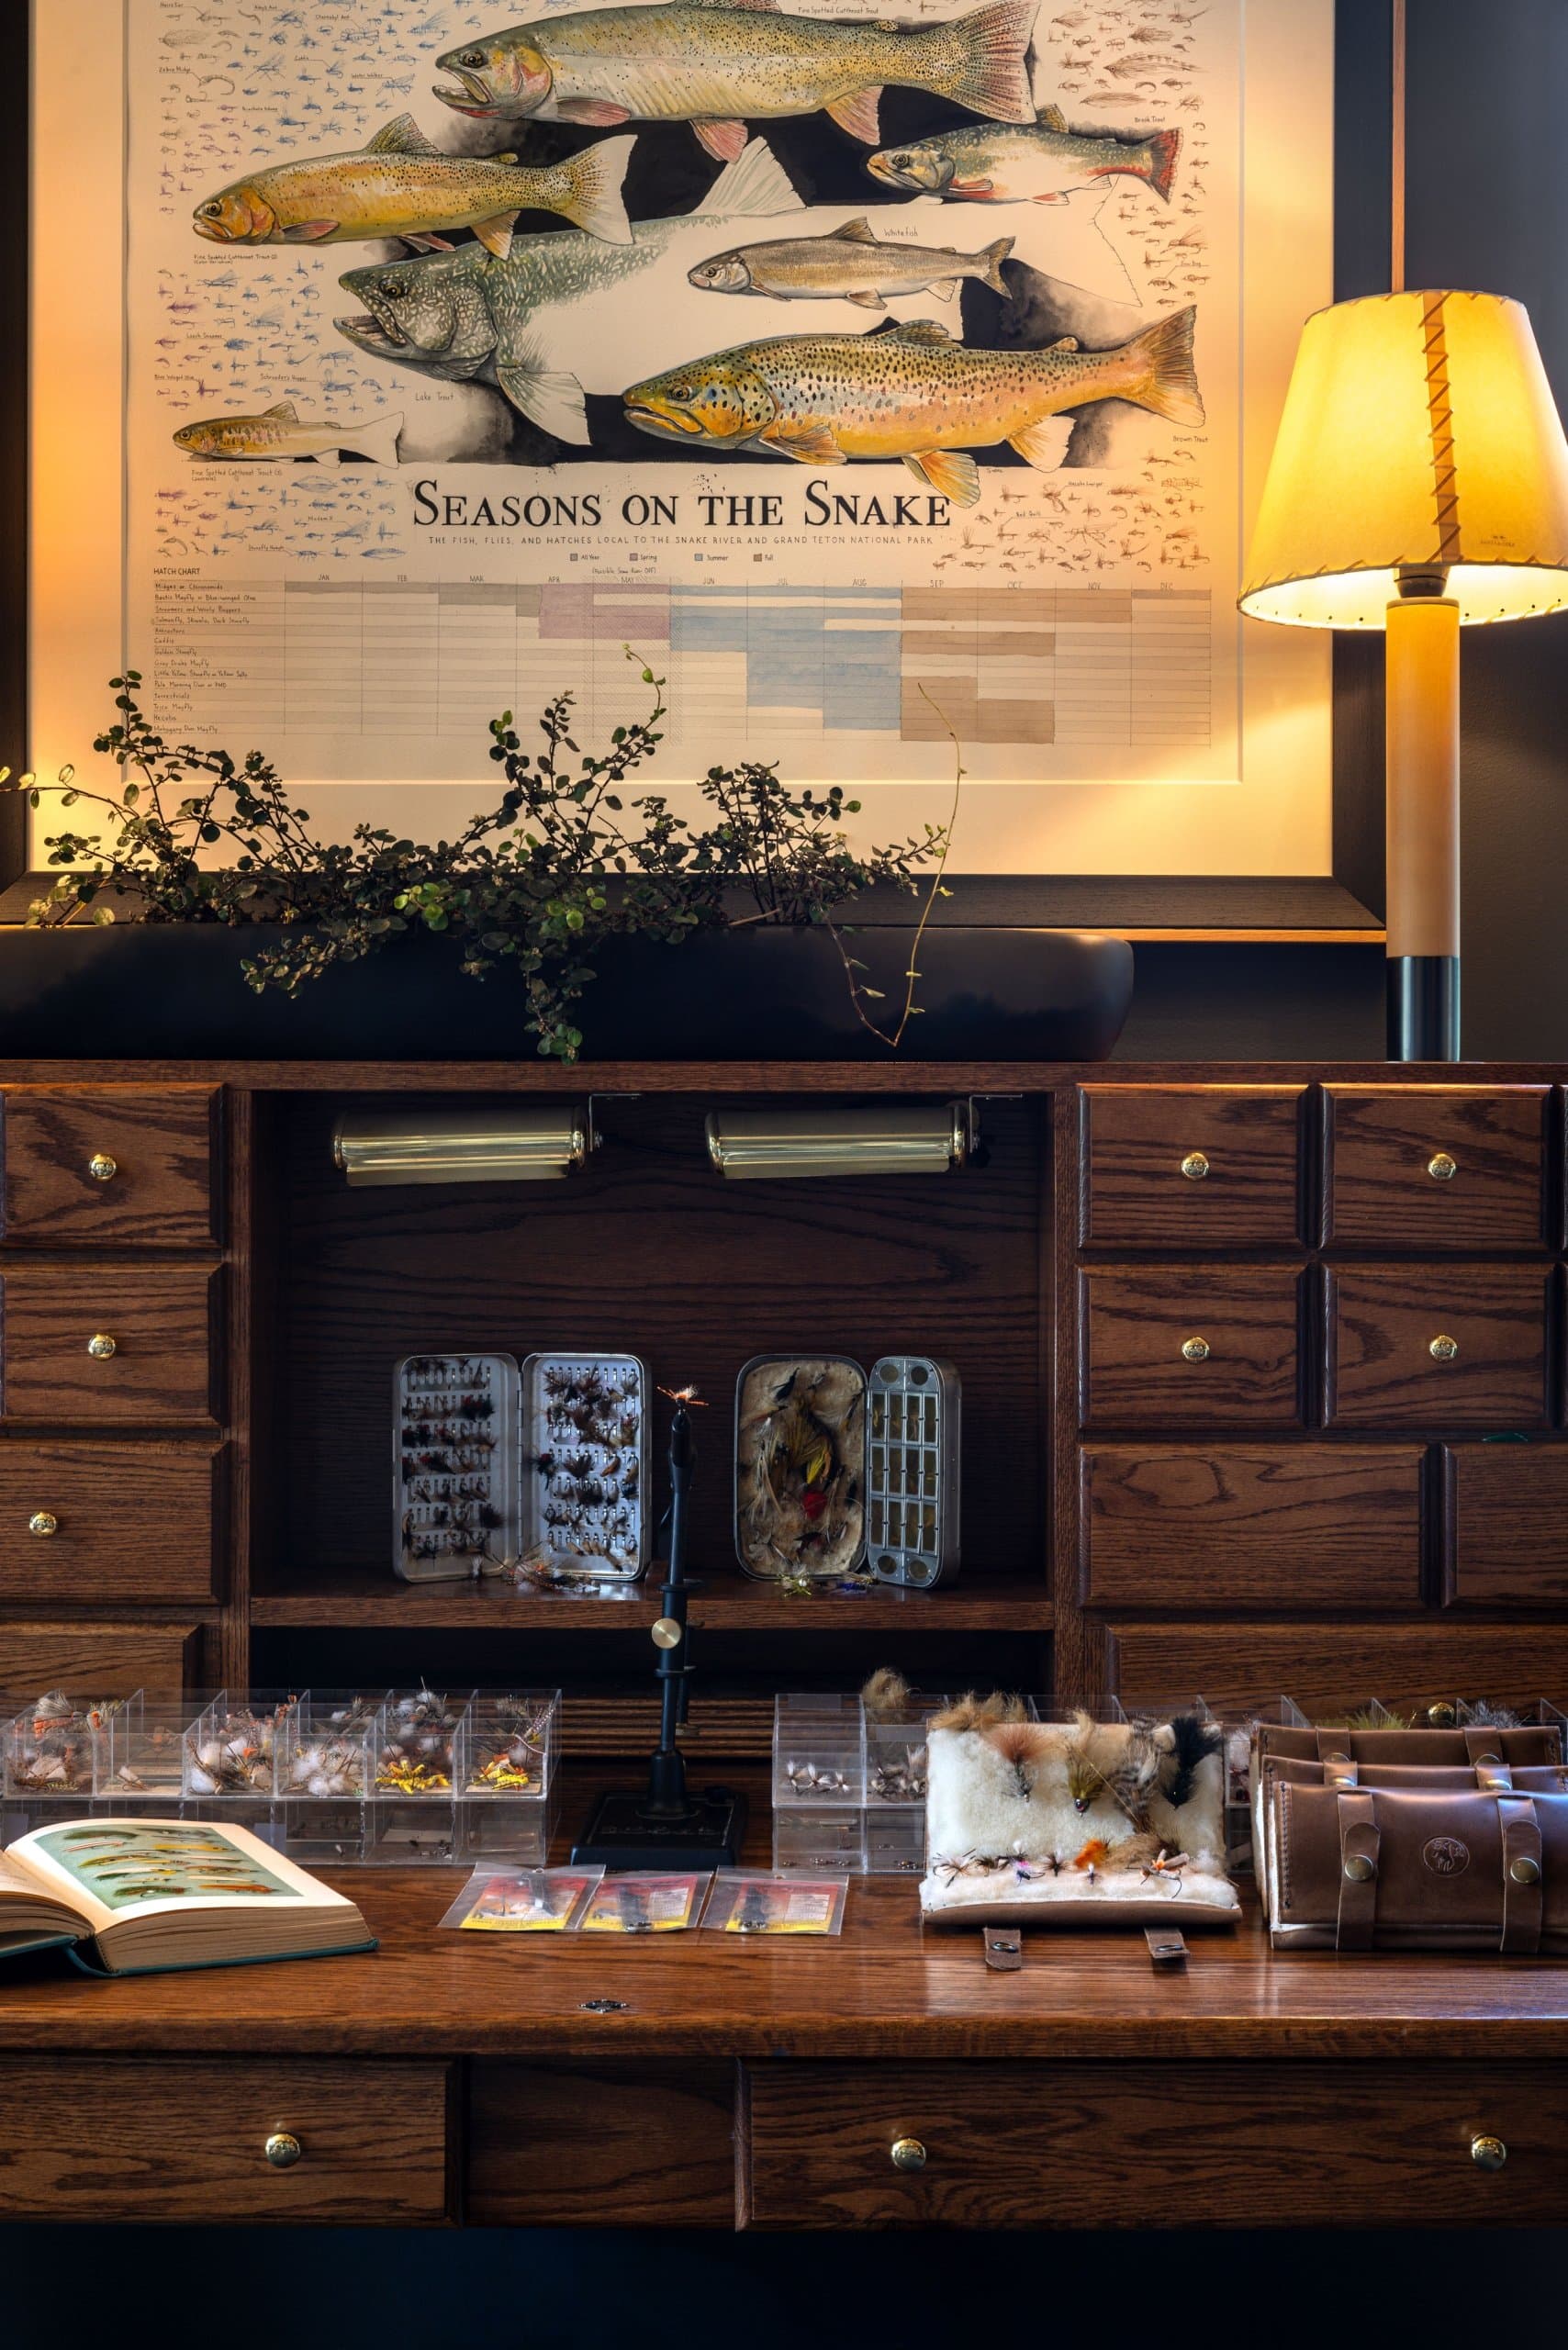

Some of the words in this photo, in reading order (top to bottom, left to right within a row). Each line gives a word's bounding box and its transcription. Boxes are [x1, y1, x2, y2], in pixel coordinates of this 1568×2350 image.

[416, 392, 431, 401] Lake
[436, 392, 454, 401] Trout
[698, 496, 783, 526] THE
[428, 536, 446, 544] THE
[453, 536, 477, 545] FISH,
[485, 536, 514, 545] FLIES,
[521, 536, 542, 544] AND
[547, 536, 592, 544] HATCHES
[597, 536, 630, 544] LOCAL
[633, 536, 647, 544] TO
[652, 536, 669, 544] THE
[675, 536, 708, 544] SNAKE
[712, 536, 742, 544] RIVER
[747, 536, 767, 544] AND
[774, 536, 807, 544] GRAND
[812, 536, 845, 544] TETON
[850, 536, 902, 544] NATIONAL
[907, 536, 933, 544] PARK
